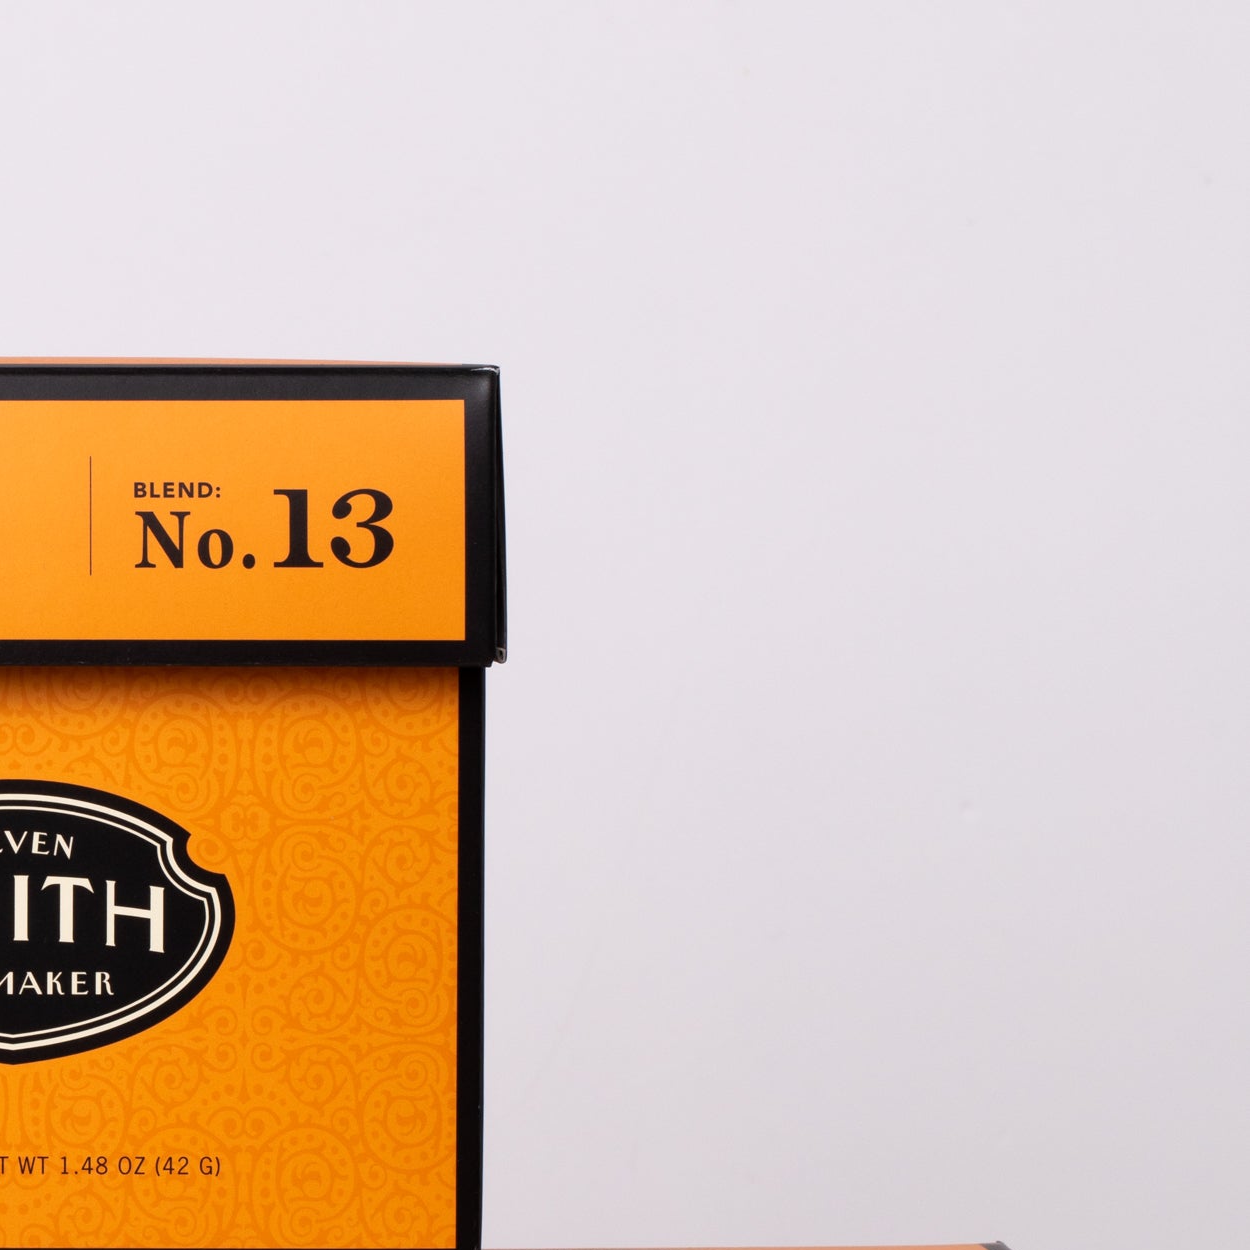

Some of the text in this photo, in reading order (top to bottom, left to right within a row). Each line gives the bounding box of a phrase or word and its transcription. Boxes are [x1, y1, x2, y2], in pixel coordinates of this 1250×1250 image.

[133, 481, 221, 499] BLEND:
[17, 1155, 50, 1175] WT
[60, 1155, 108, 1176] 1.48
[117, 1155, 146, 1176] OZ
[155, 1156, 189, 1177] (42
[199, 1156, 221, 1177] G)
